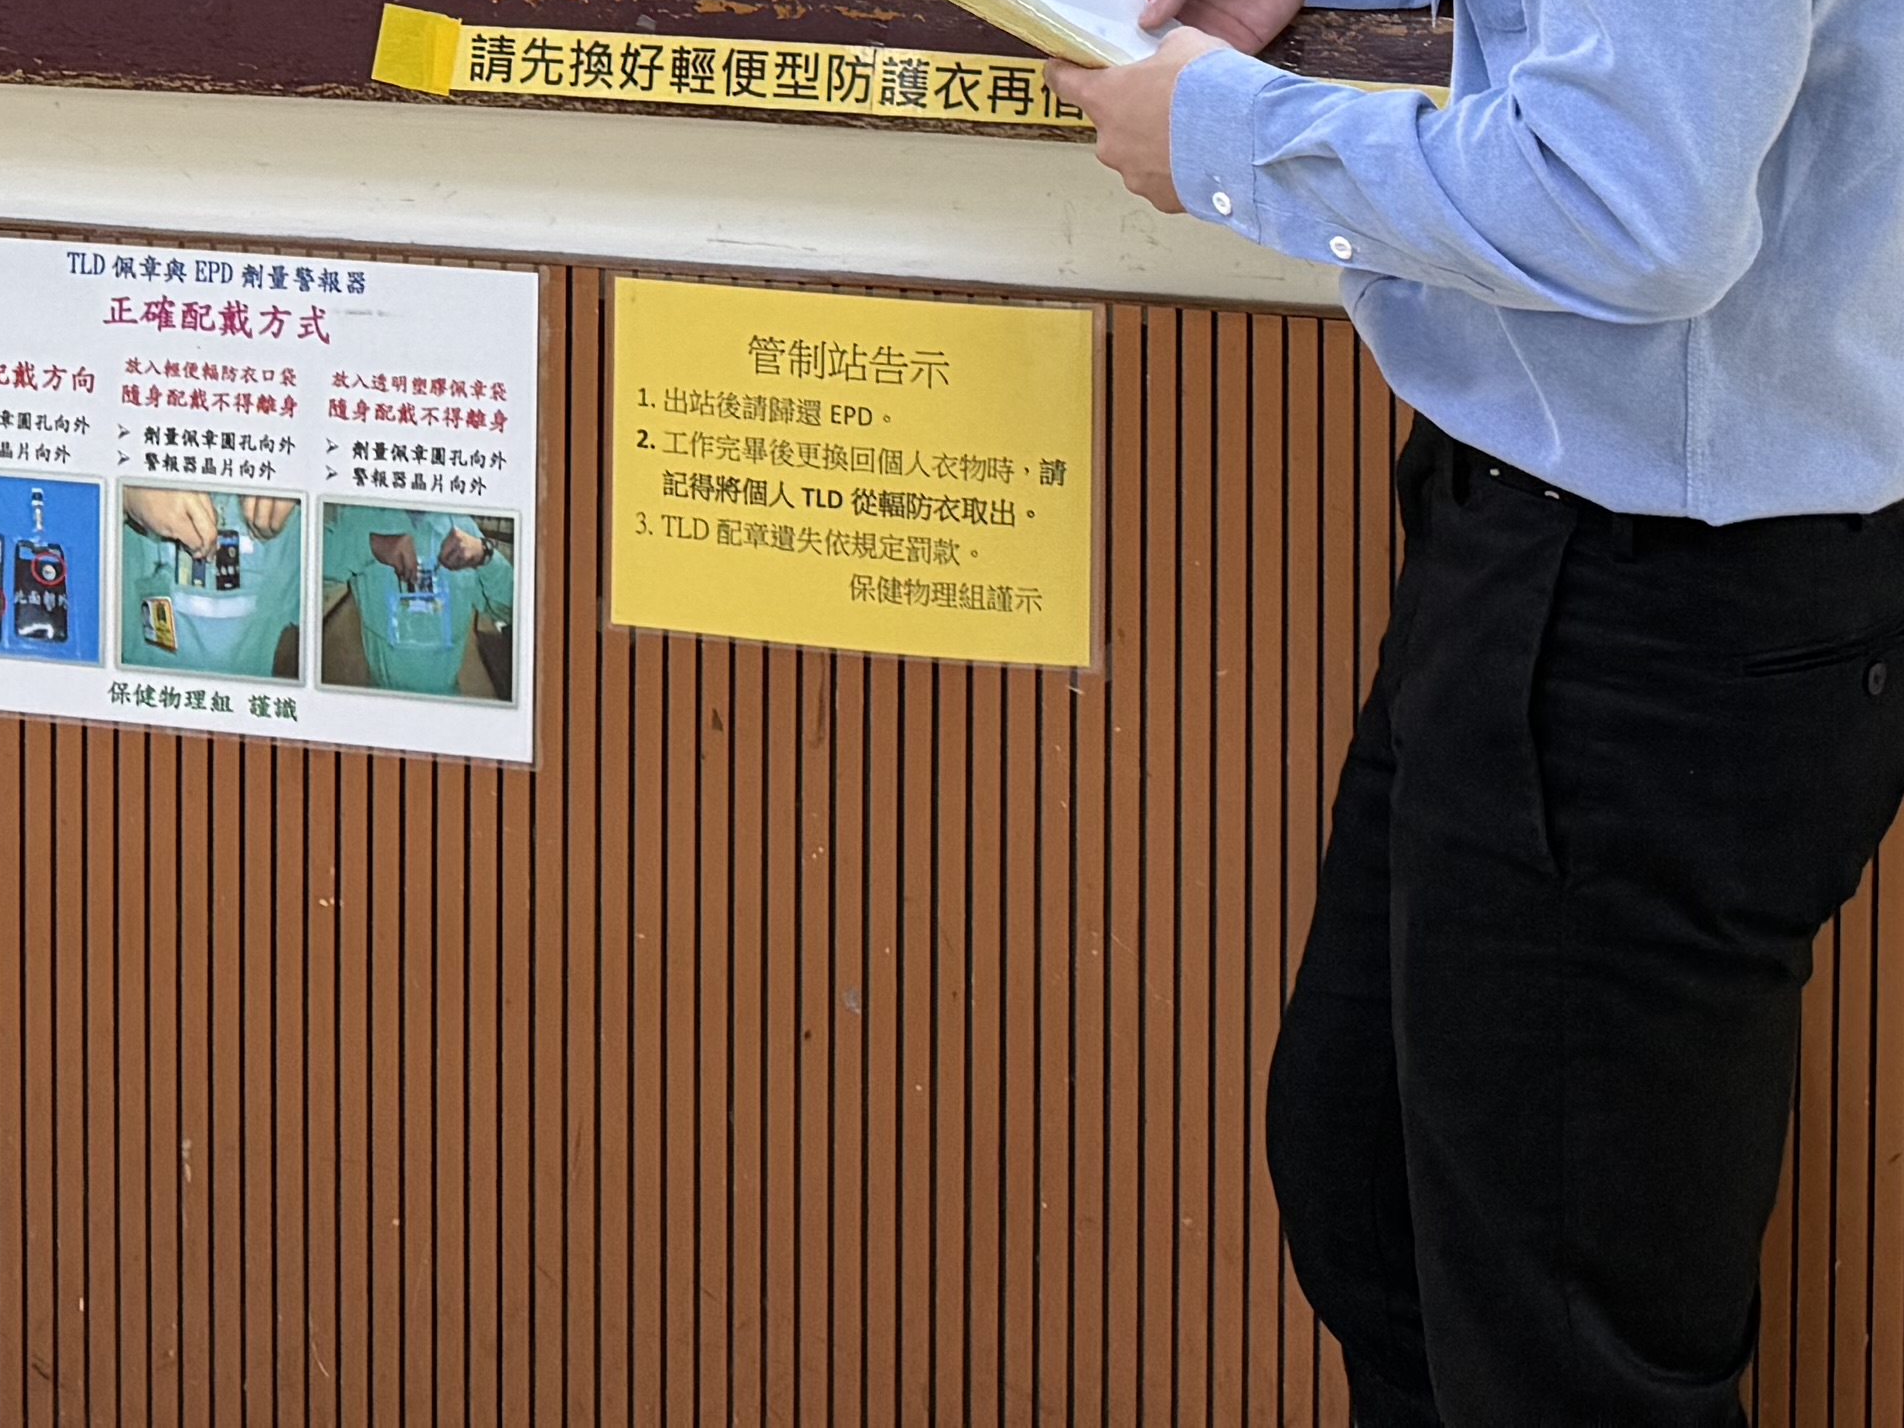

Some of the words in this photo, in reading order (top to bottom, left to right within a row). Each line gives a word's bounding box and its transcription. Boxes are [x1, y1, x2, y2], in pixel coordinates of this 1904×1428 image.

[66, 251, 105, 277] TLD
[113, 255, 188, 285] 佩章與
[195, 259, 234, 285] EPD
[241, 264, 367, 295] 劑量警報器
[104, 296, 331, 345] 正確配戴方式
[748, 335, 950, 389] 管制站告示
[121, 384, 298, 419] 隨身配戴不得離身
[328, 397, 509, 433] 隨身配戴不得離身
[637, 388, 656, 409] 1.
[663, 387, 821, 427] 出站後請歸還
[637, 429, 656, 450] 2.
[144, 452, 277, 481] 警報器晶片向外
[352, 466, 488, 496] 警報器晶片向外
[662, 470, 794, 509] 記得將個人
[801, 486, 843, 509] TLD
[635, 513, 654, 536] 3.
[661, 515, 709, 541] TLD
[850, 573, 1043, 614] 保健物理組謹示
[107, 681, 234, 715] 保健物理組
[249, 693, 298, 723] 謹識
